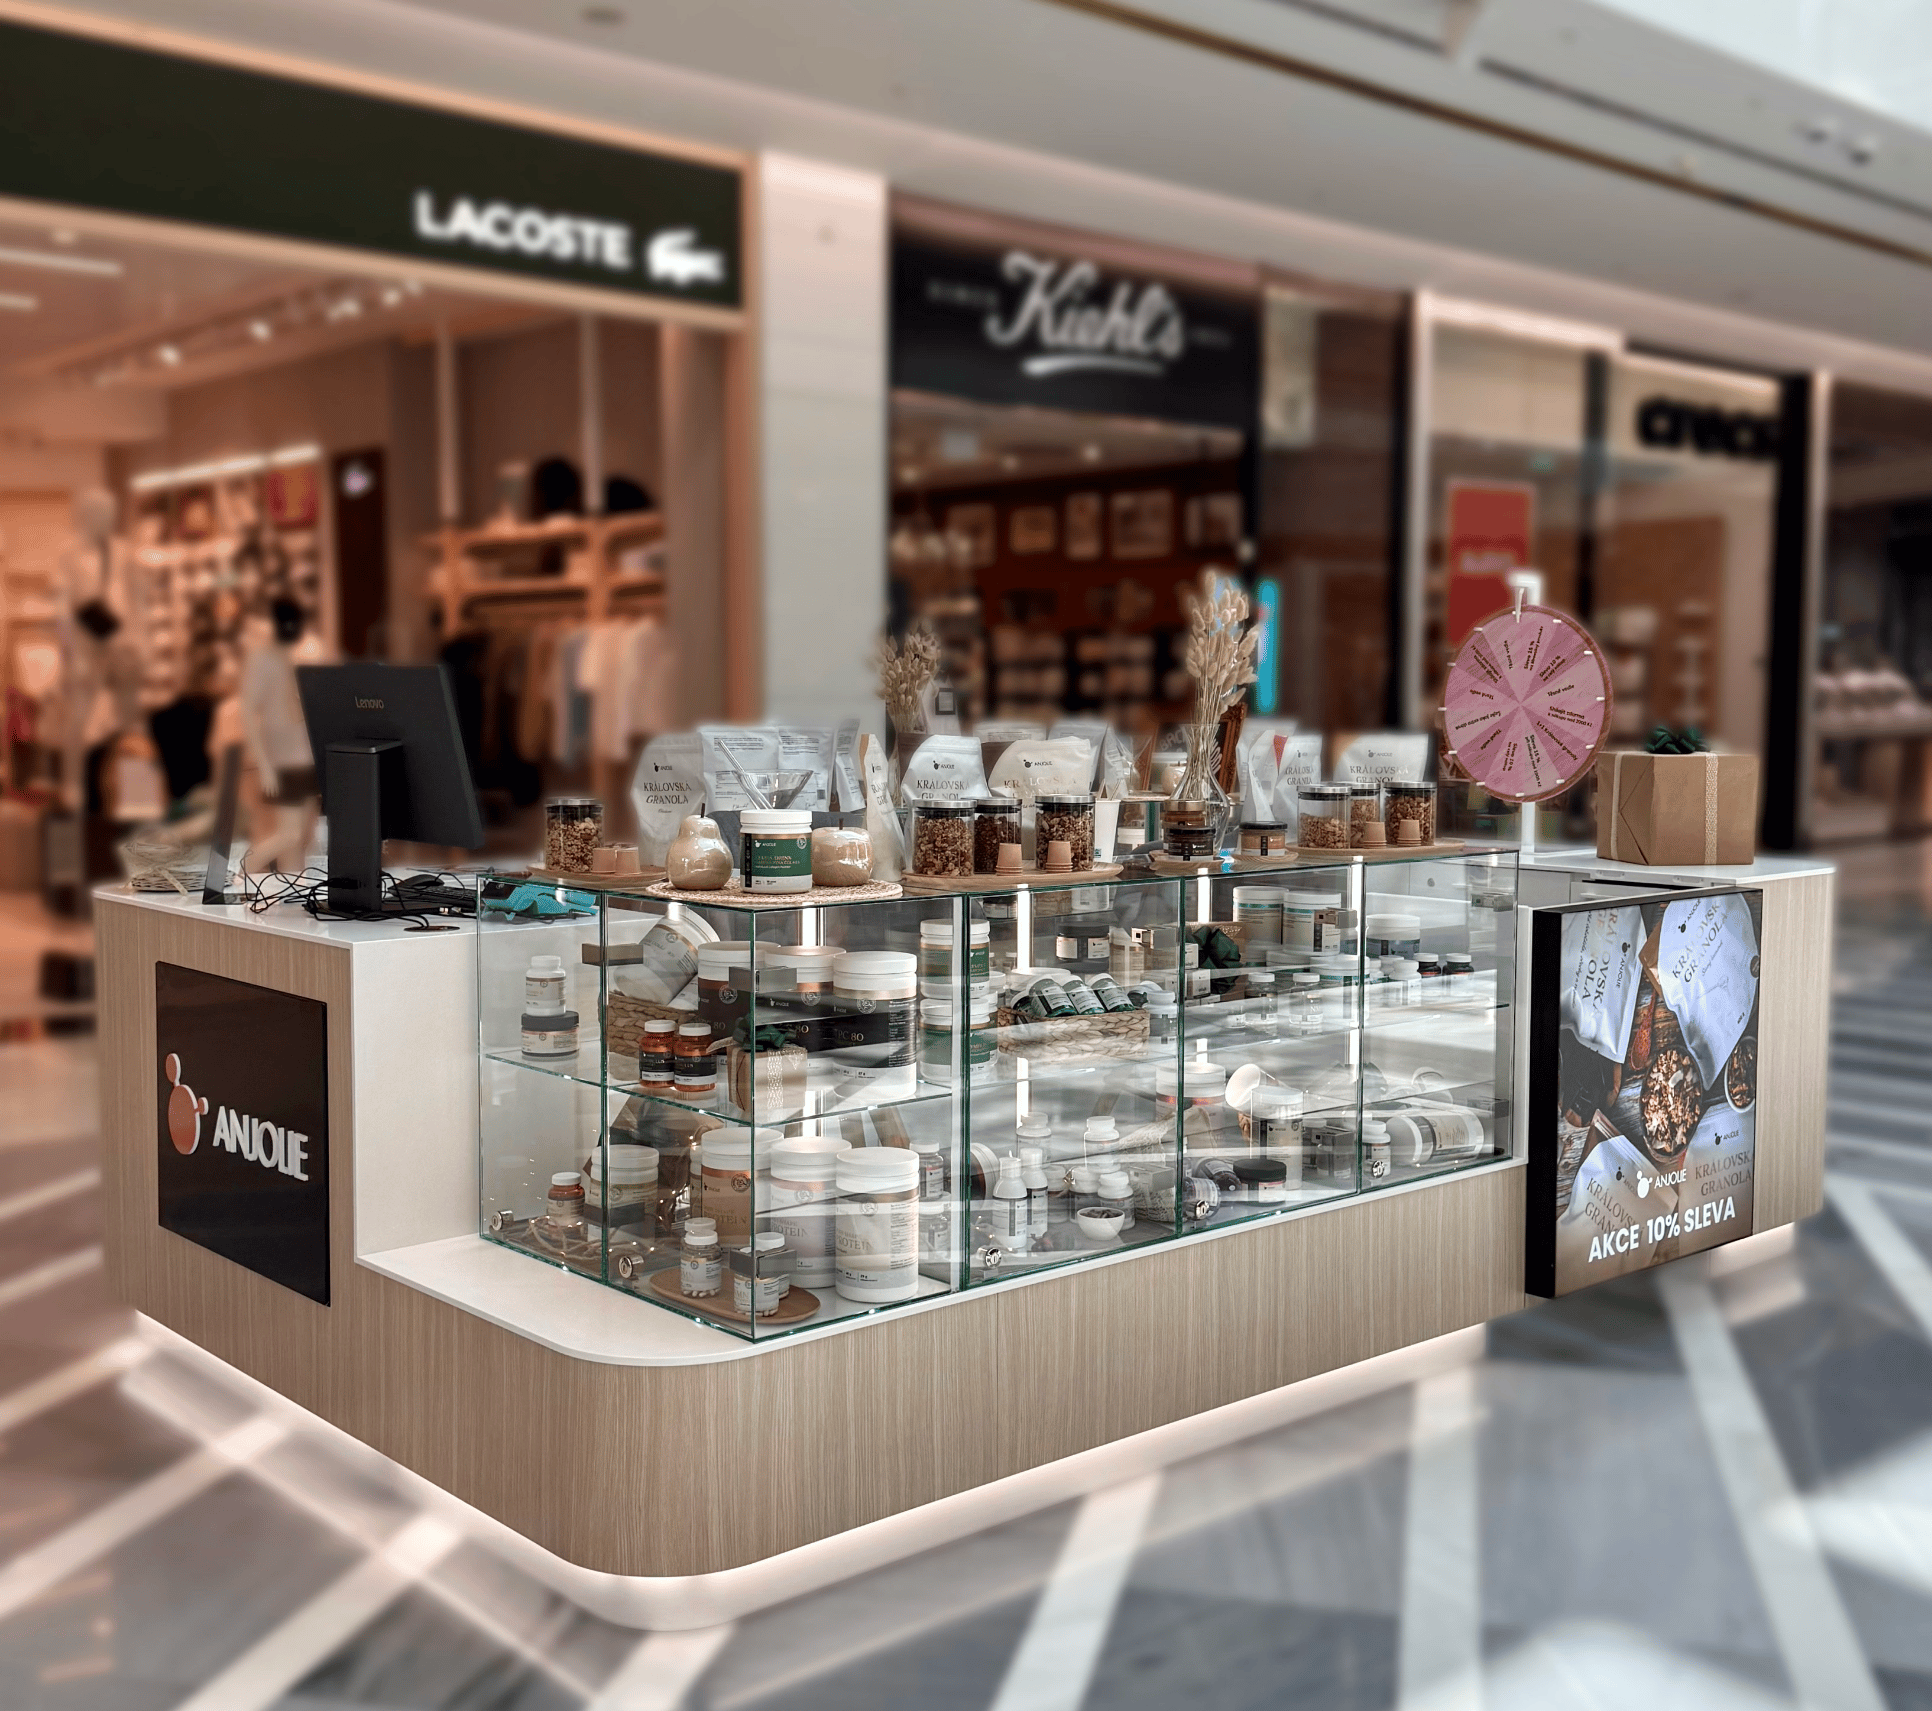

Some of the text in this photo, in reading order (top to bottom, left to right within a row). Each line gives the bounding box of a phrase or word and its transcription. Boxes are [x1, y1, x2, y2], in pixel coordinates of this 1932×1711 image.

[414, 191, 632, 270] LACOSTE
[354, 696, 385, 709] Lenovo
[643, 780, 692, 792] KRÁLOVSKÁ
[646, 794, 689, 805] GRANOLA
[850, 1032, 864, 1042] 80
[212, 1105, 309, 1182] ANJOLIE
[1654, 1168, 1687, 1190] ANJOLIE
[1700, 1168, 1752, 1196] GRANOLA
[1588, 1196, 1736, 1263] AKCE 10% SLEVA
